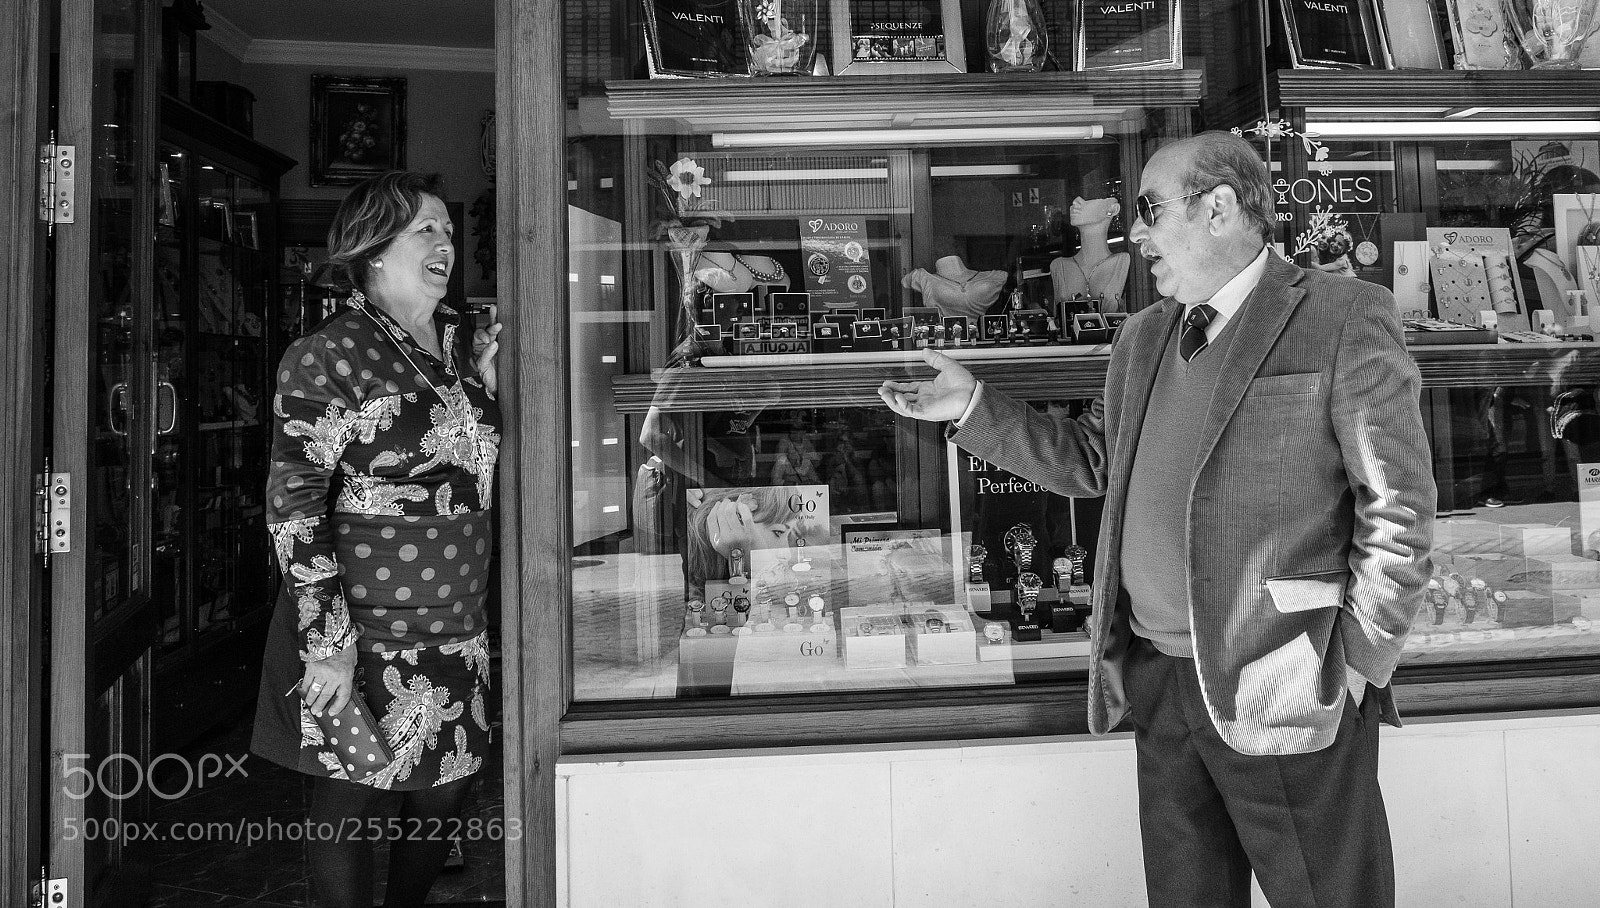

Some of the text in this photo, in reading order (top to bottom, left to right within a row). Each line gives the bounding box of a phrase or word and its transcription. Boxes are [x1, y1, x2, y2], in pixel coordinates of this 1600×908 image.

[1100, 1, 1155, 15] VALENTI
[1304, 1, 1348, 14] VALENTI
[671, 11, 724, 24] VALENTI
[823, 222, 858, 231] ADORO
[1459, 235, 1493, 243] ADORO
[787, 493, 817, 513] Go
[799, 641, 824, 657] Go
